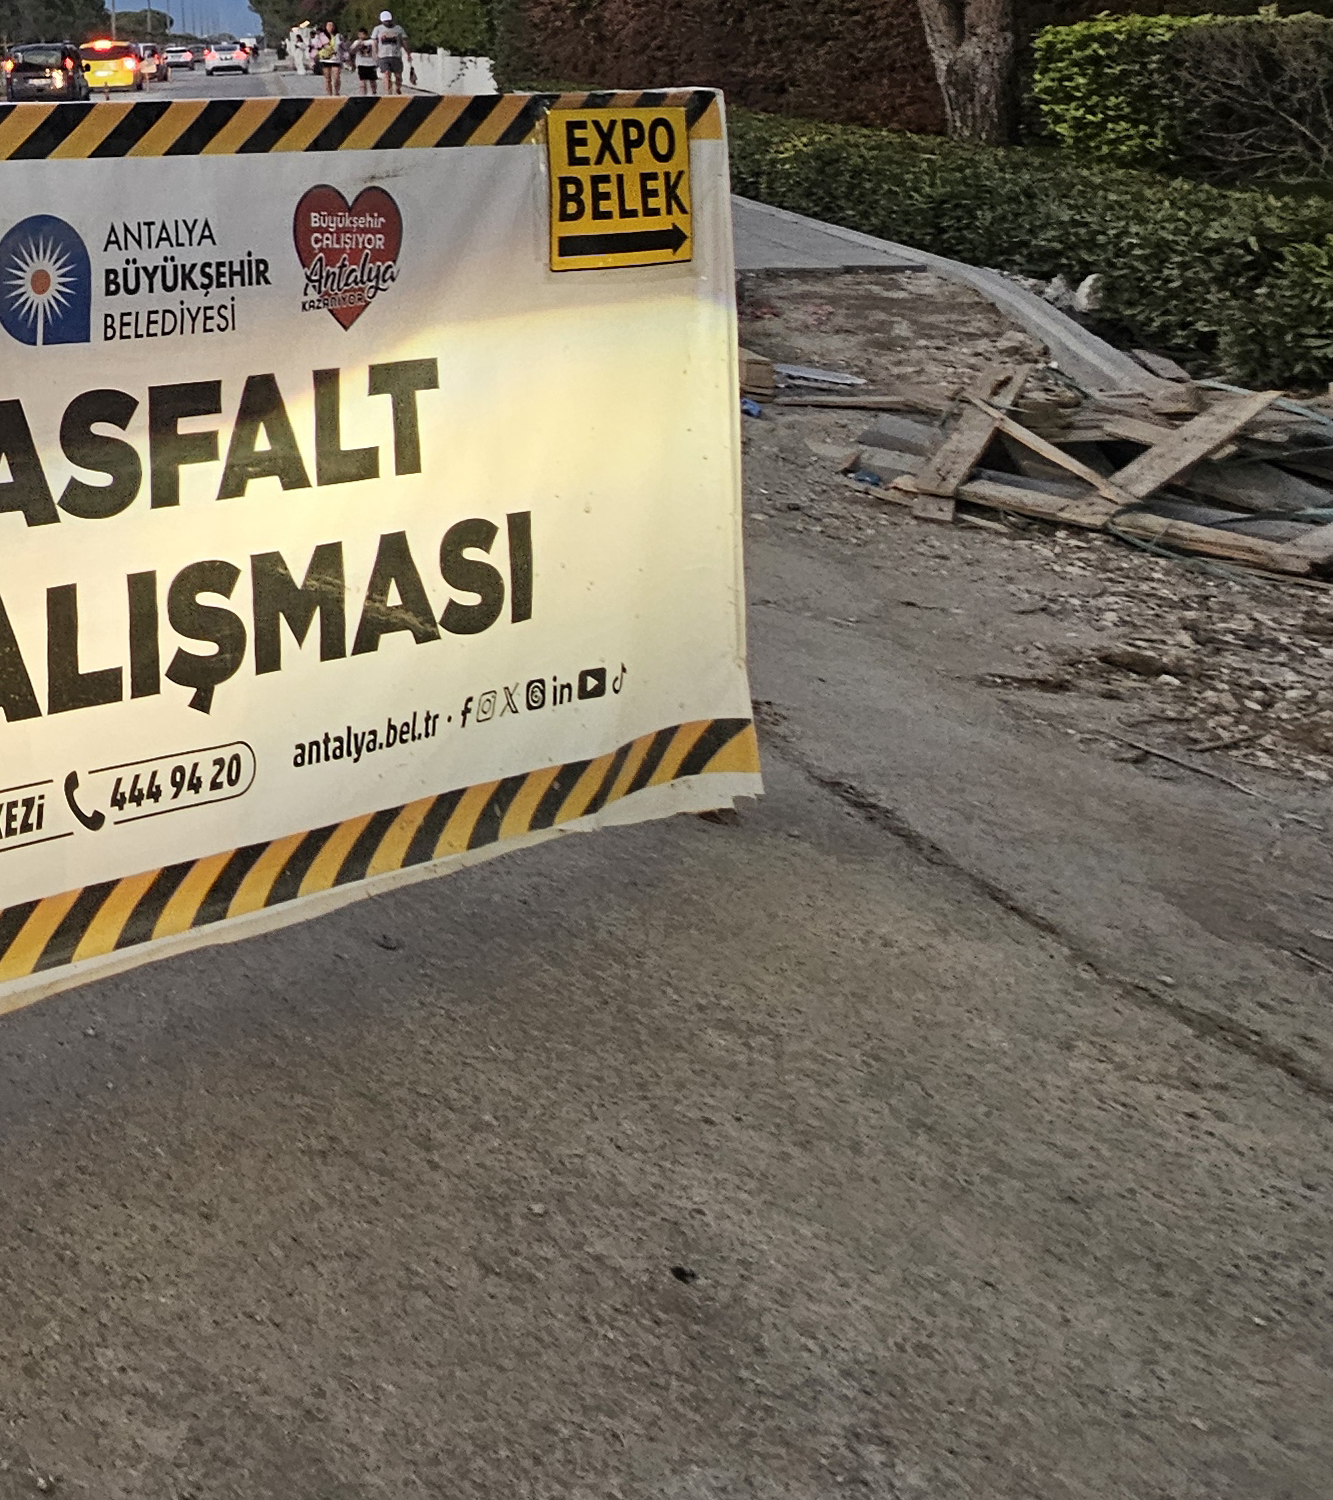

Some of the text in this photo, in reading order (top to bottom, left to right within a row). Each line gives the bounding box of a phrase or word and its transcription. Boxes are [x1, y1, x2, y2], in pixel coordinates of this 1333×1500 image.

[565, 117, 676, 167] EXPO
[557, 170, 689, 222] BELEK
[103, 217, 217, 252] ANTALYA
[310, 211, 386, 232] Büyükşehir
[311, 232, 385, 253] ÇALIŞIYOR
[104, 250, 273, 298] BÜYÜKŞEHİR
[303, 249, 400, 300] Antalya
[103, 297, 236, 341] BELEDİYESİ
[293, 710, 439, 768] antalya.bel.tr
[110, 773, 163, 812] 444
[169, 762, 205, 802] 94
[209, 752, 242, 792] 20
